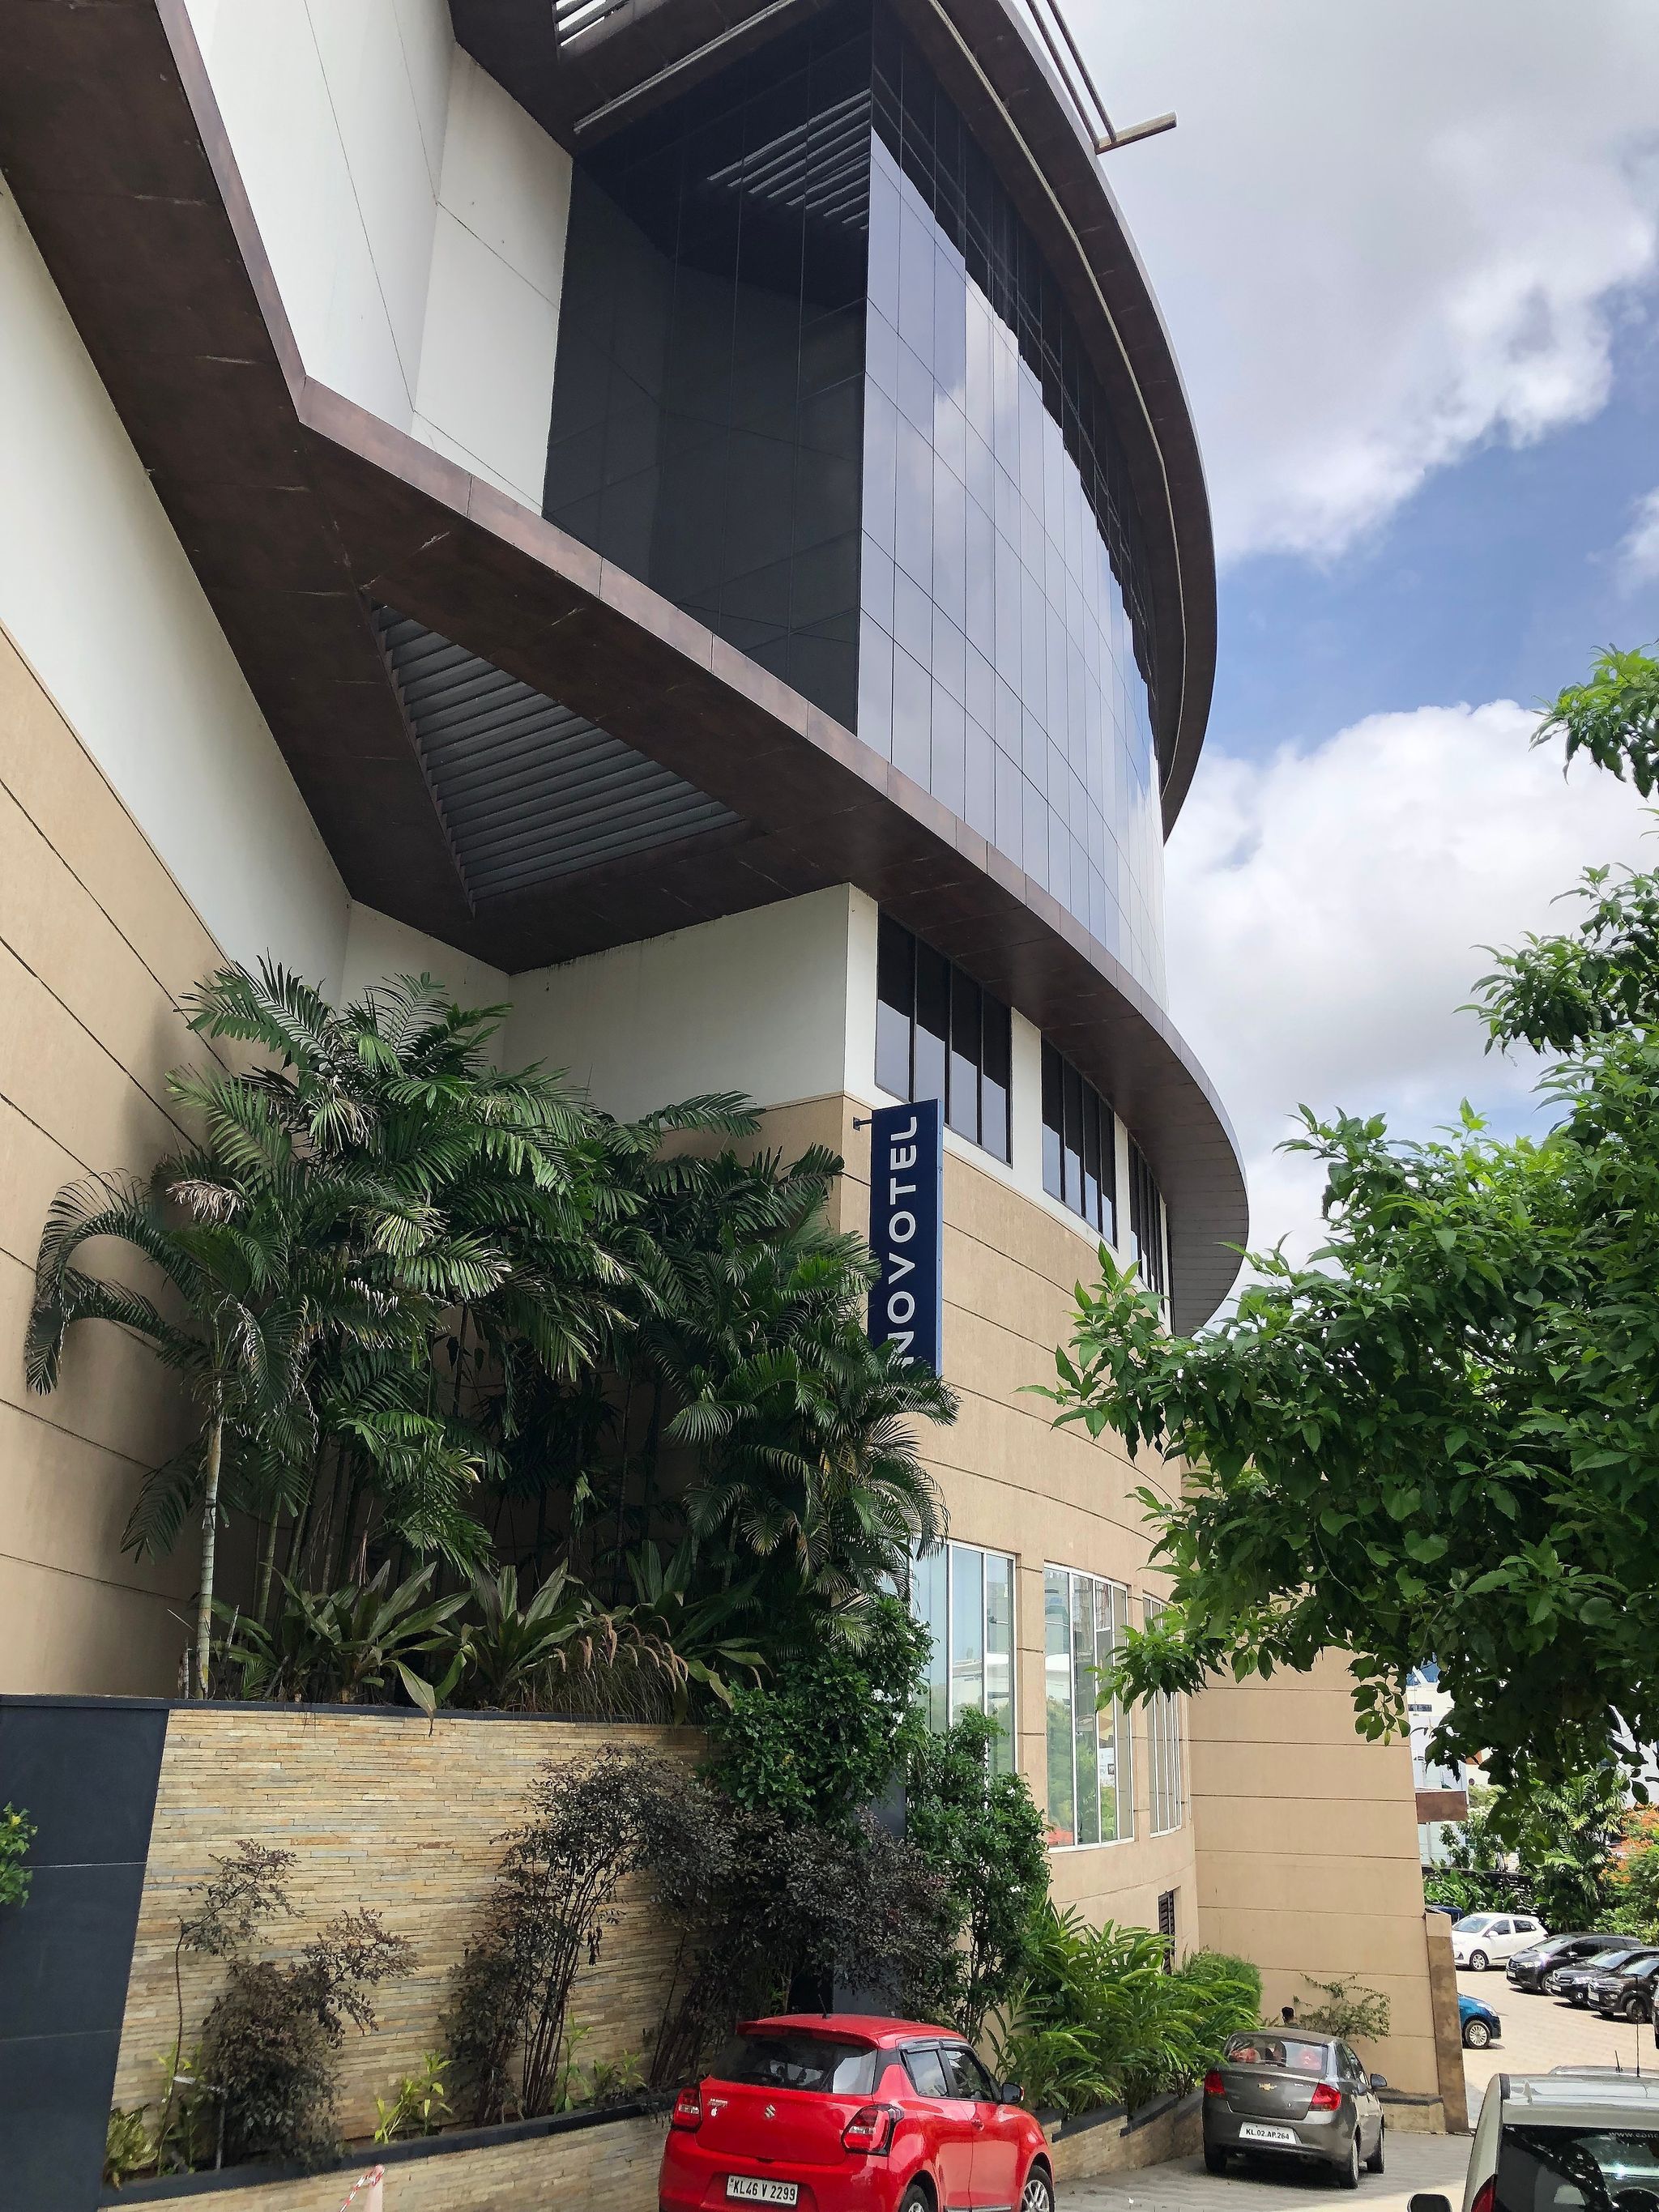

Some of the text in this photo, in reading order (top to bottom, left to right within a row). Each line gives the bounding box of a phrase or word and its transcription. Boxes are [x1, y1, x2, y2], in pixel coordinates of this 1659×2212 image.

[887, 1116, 917, 1368] NOVOTEL
[733, 2180, 758, 2196] KL46
[761, 2184, 768, 2197] V
[770, 2185, 795, 2201] 2299
